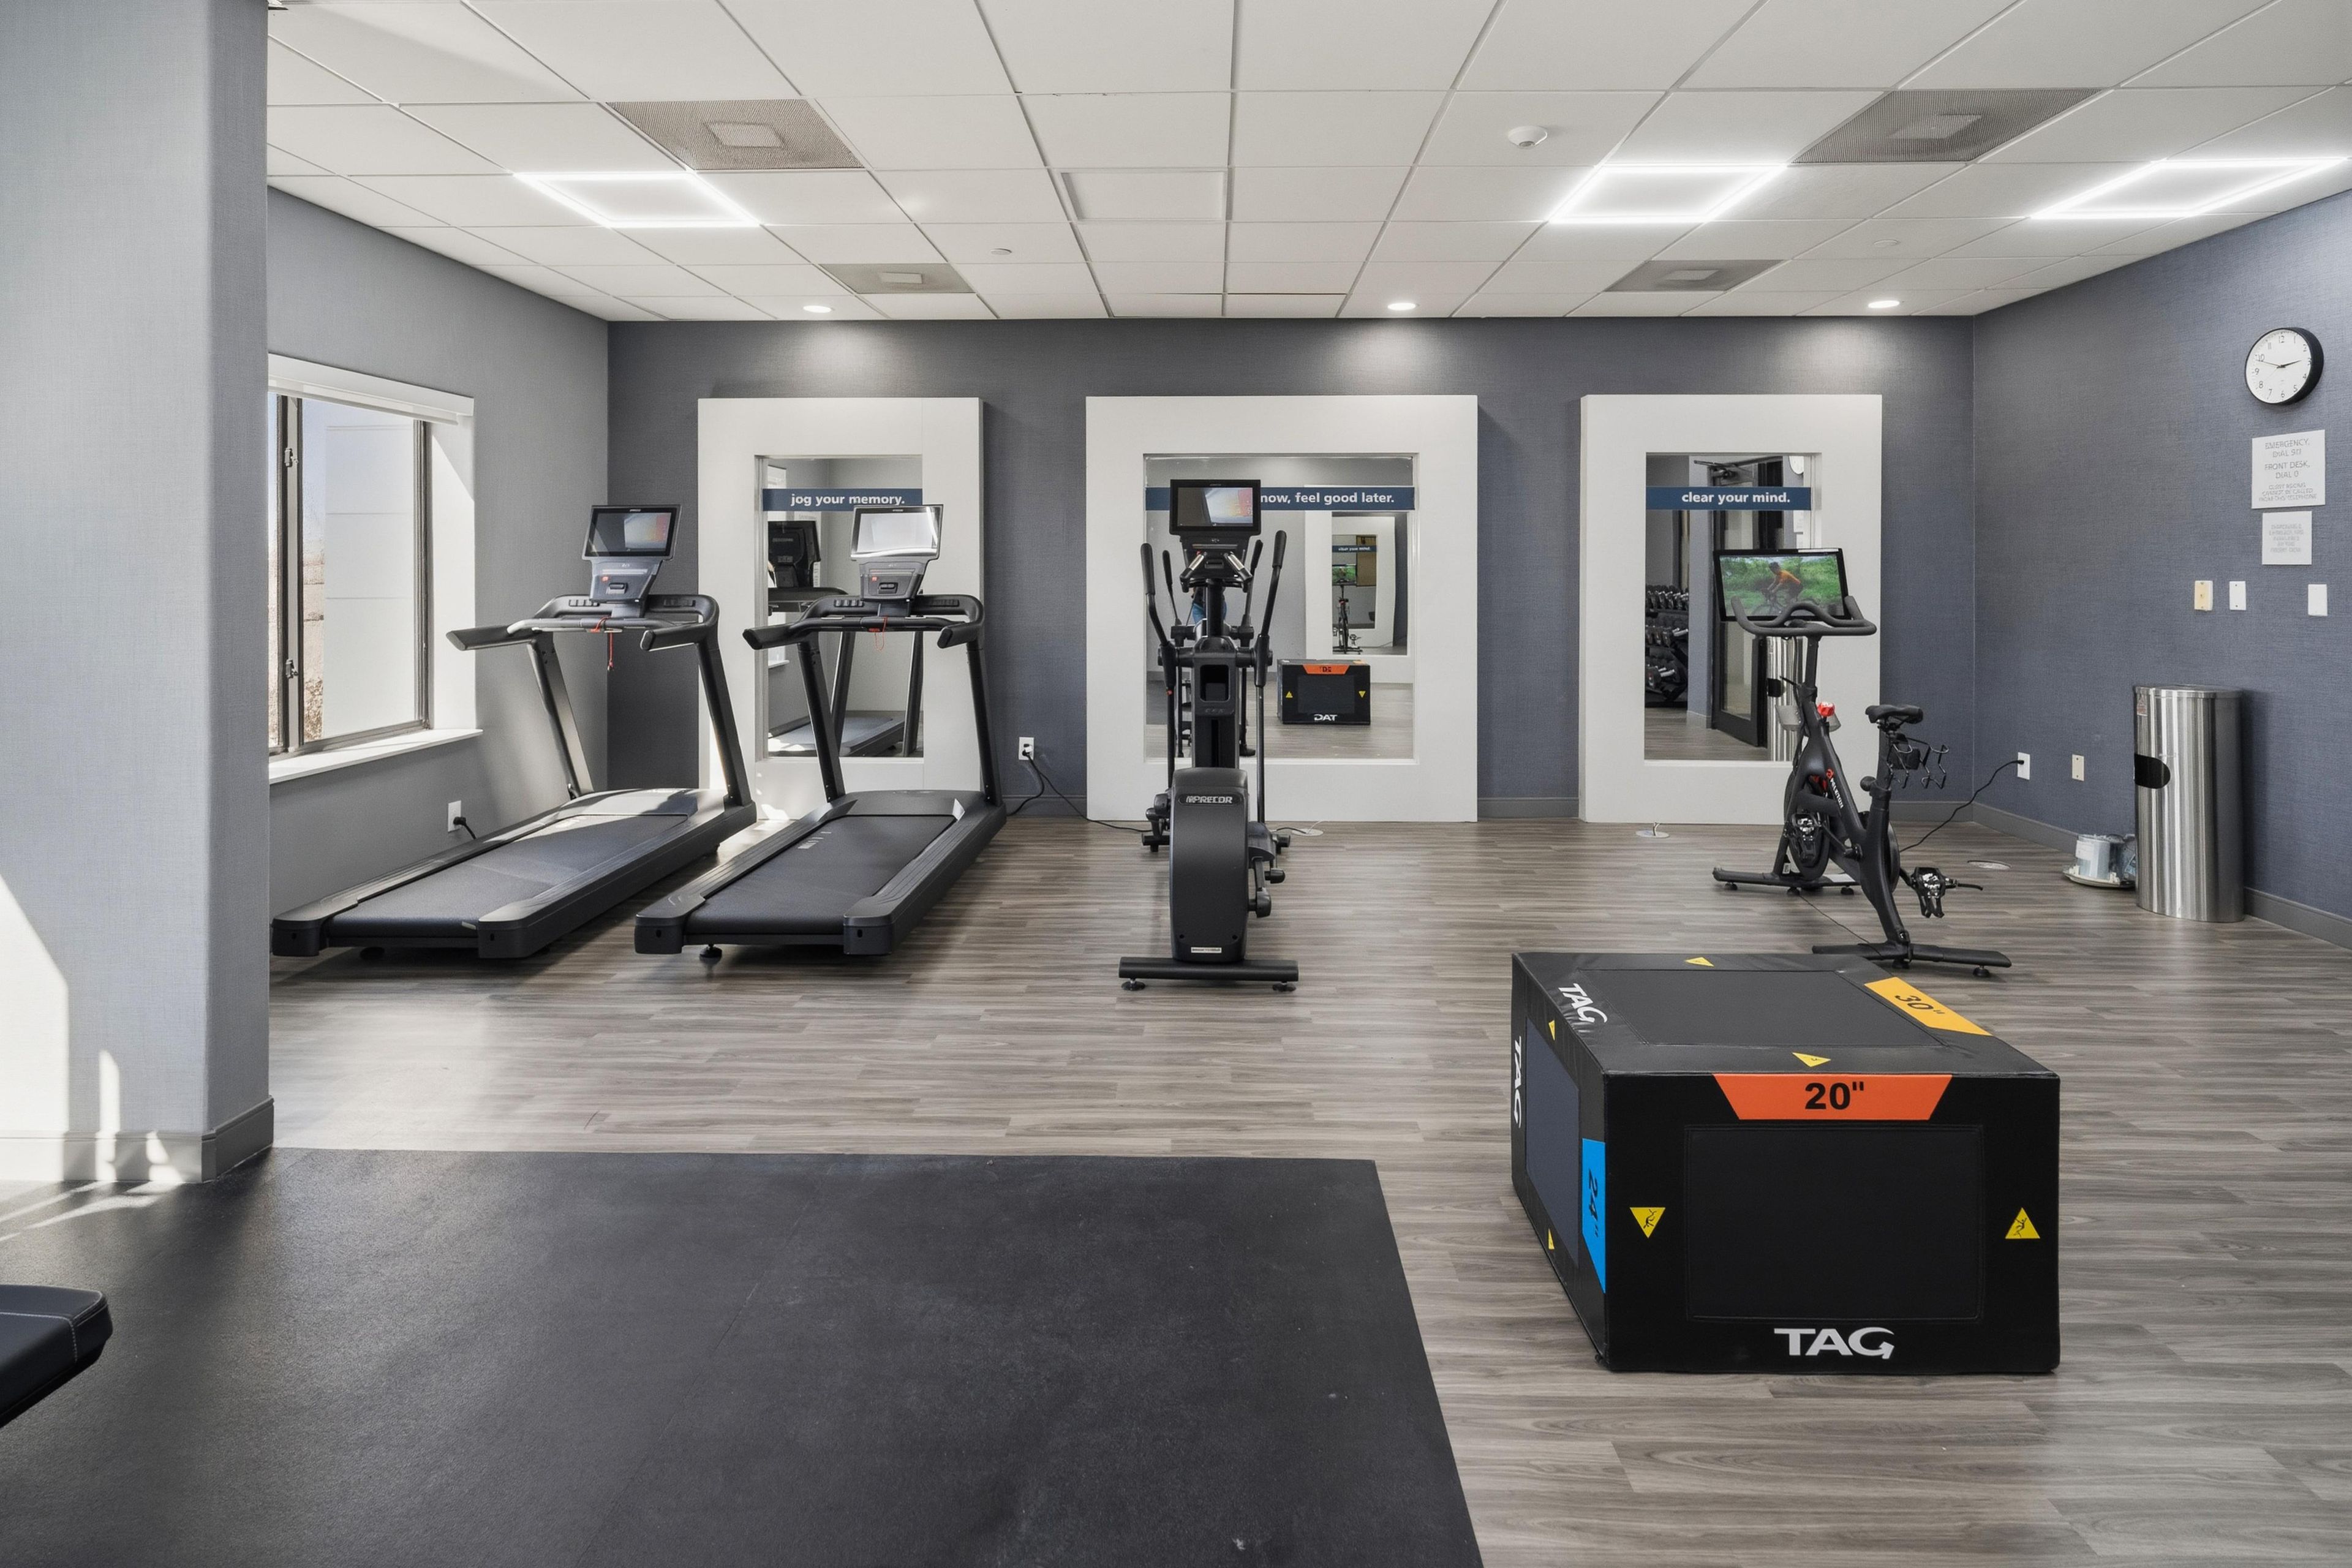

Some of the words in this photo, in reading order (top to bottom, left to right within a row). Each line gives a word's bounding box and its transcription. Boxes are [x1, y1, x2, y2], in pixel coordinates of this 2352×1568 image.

[2303, 344, 2307, 352] 2
[2258, 353, 2265, 362] 10
[2307, 357, 2312, 366] 3
[2258, 380, 2264, 389] 8
[2267, 388, 2272, 399] 7
[2280, 390, 2285, 398] 6
[791, 494, 812, 507] jog
[815, 496, 845, 507] your
[849, 496, 905, 506] memory.
[1261, 494, 1291, 504] now,
[1295, 492, 1320, 503] feel
[1324, 492, 1357, 505] good
[1362, 492, 1394, 503] later.
[1681, 492, 1714, 503] clear
[1717, 494, 1749, 505] your
[1752, 492, 1790, 503] mind.
[1558, 983, 1608, 1023] TAG
[1894, 995, 1945, 1014] 30"
[1804, 1081, 1864, 1110] 20"
[1774, 1327, 1894, 1359] TAG
